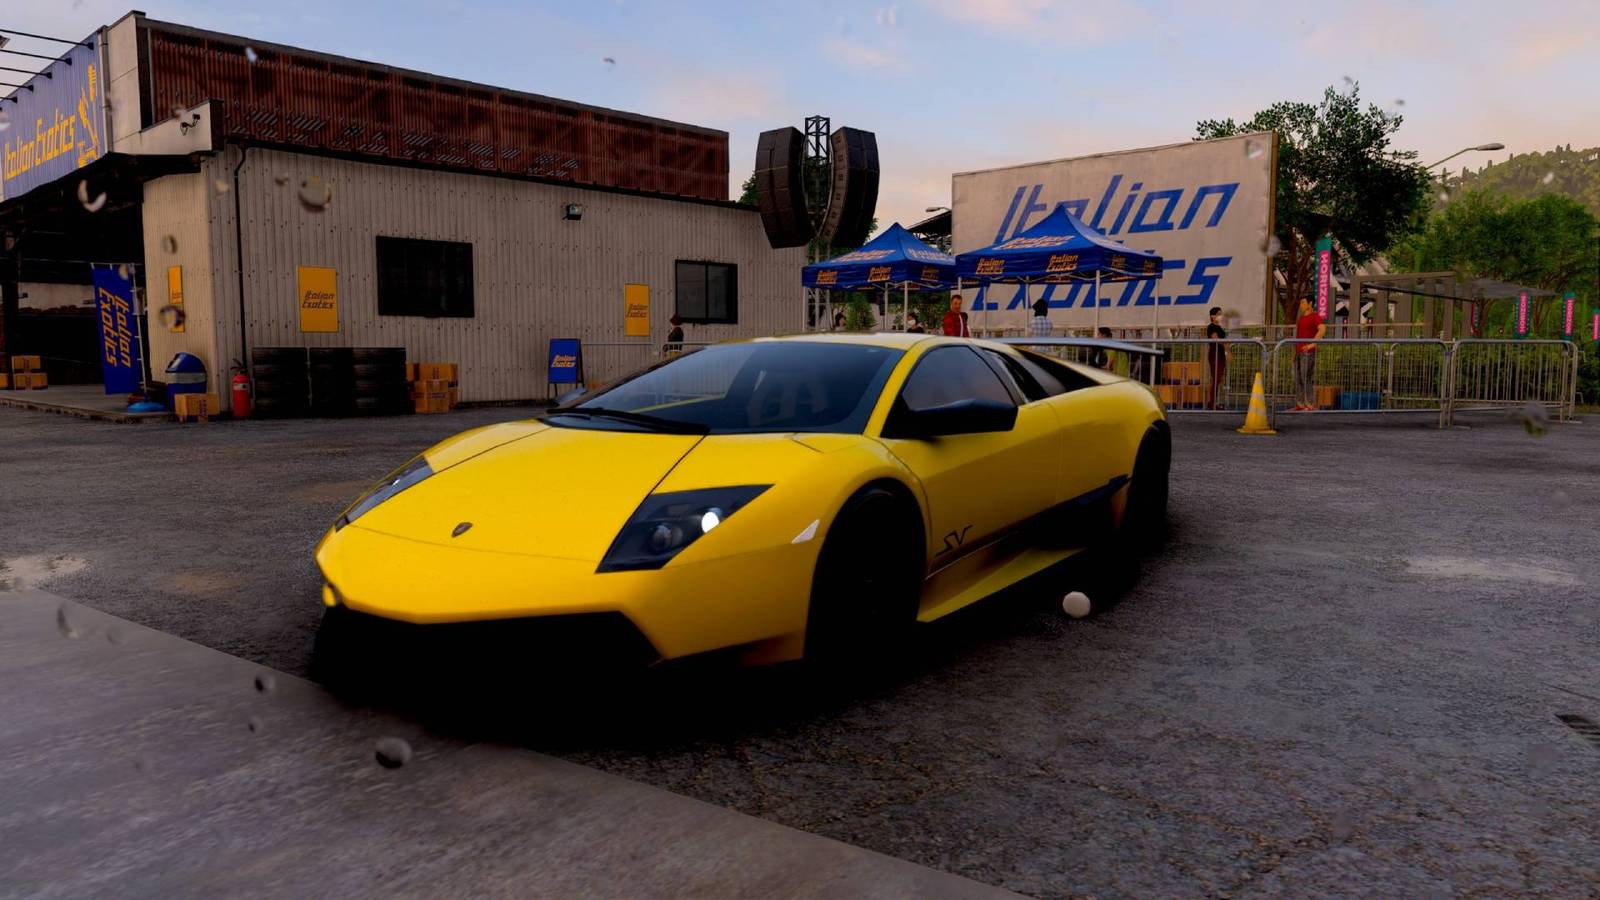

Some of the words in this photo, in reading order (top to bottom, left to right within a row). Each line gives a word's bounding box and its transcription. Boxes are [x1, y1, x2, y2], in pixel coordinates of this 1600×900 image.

[5, 136, 34, 180] Italian
[35, 106, 75, 166] Exotics
[992, 174, 1240, 247] Italian
[1049, 254, 1078, 265] Italian
[1318, 253, 1329, 317] HORIZON
[99, 287, 118, 366] Exotics
[305, 290, 335, 300] Italian
[115, 295, 132, 368] Italian
[934, 523, 974, 558] SV
